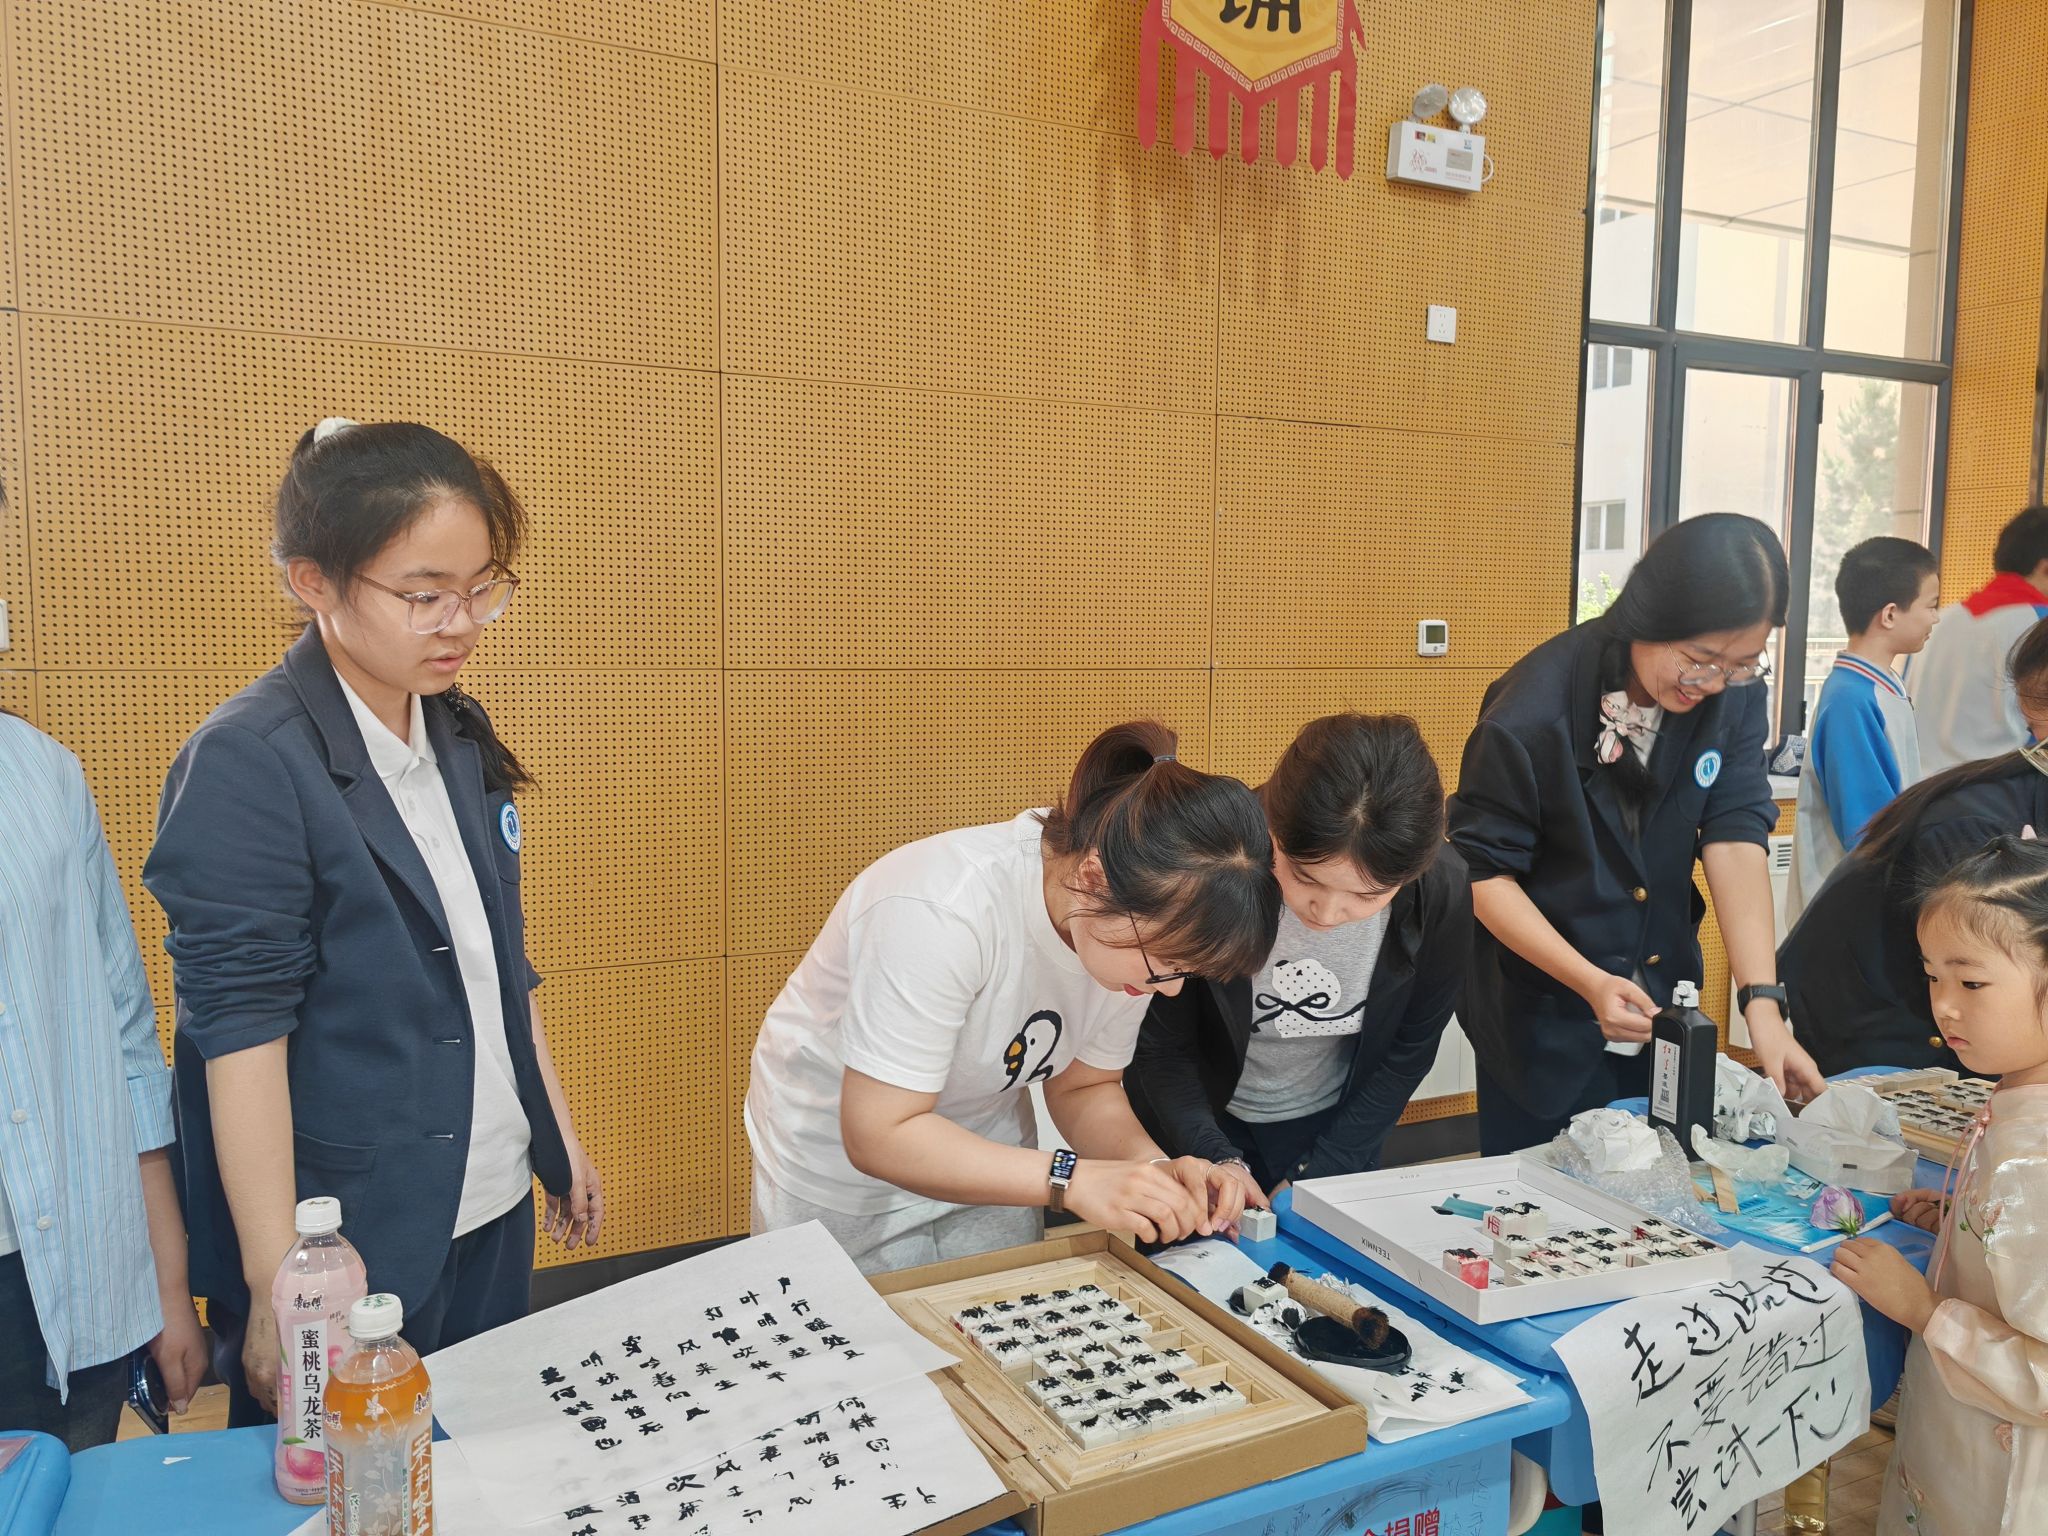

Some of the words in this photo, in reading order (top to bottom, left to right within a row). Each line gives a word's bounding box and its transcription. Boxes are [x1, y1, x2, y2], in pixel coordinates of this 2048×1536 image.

[1361, 1236, 1391, 1261] TEENMIX
[301, 1329, 322, 1439] 蜜桃乌龙茶
